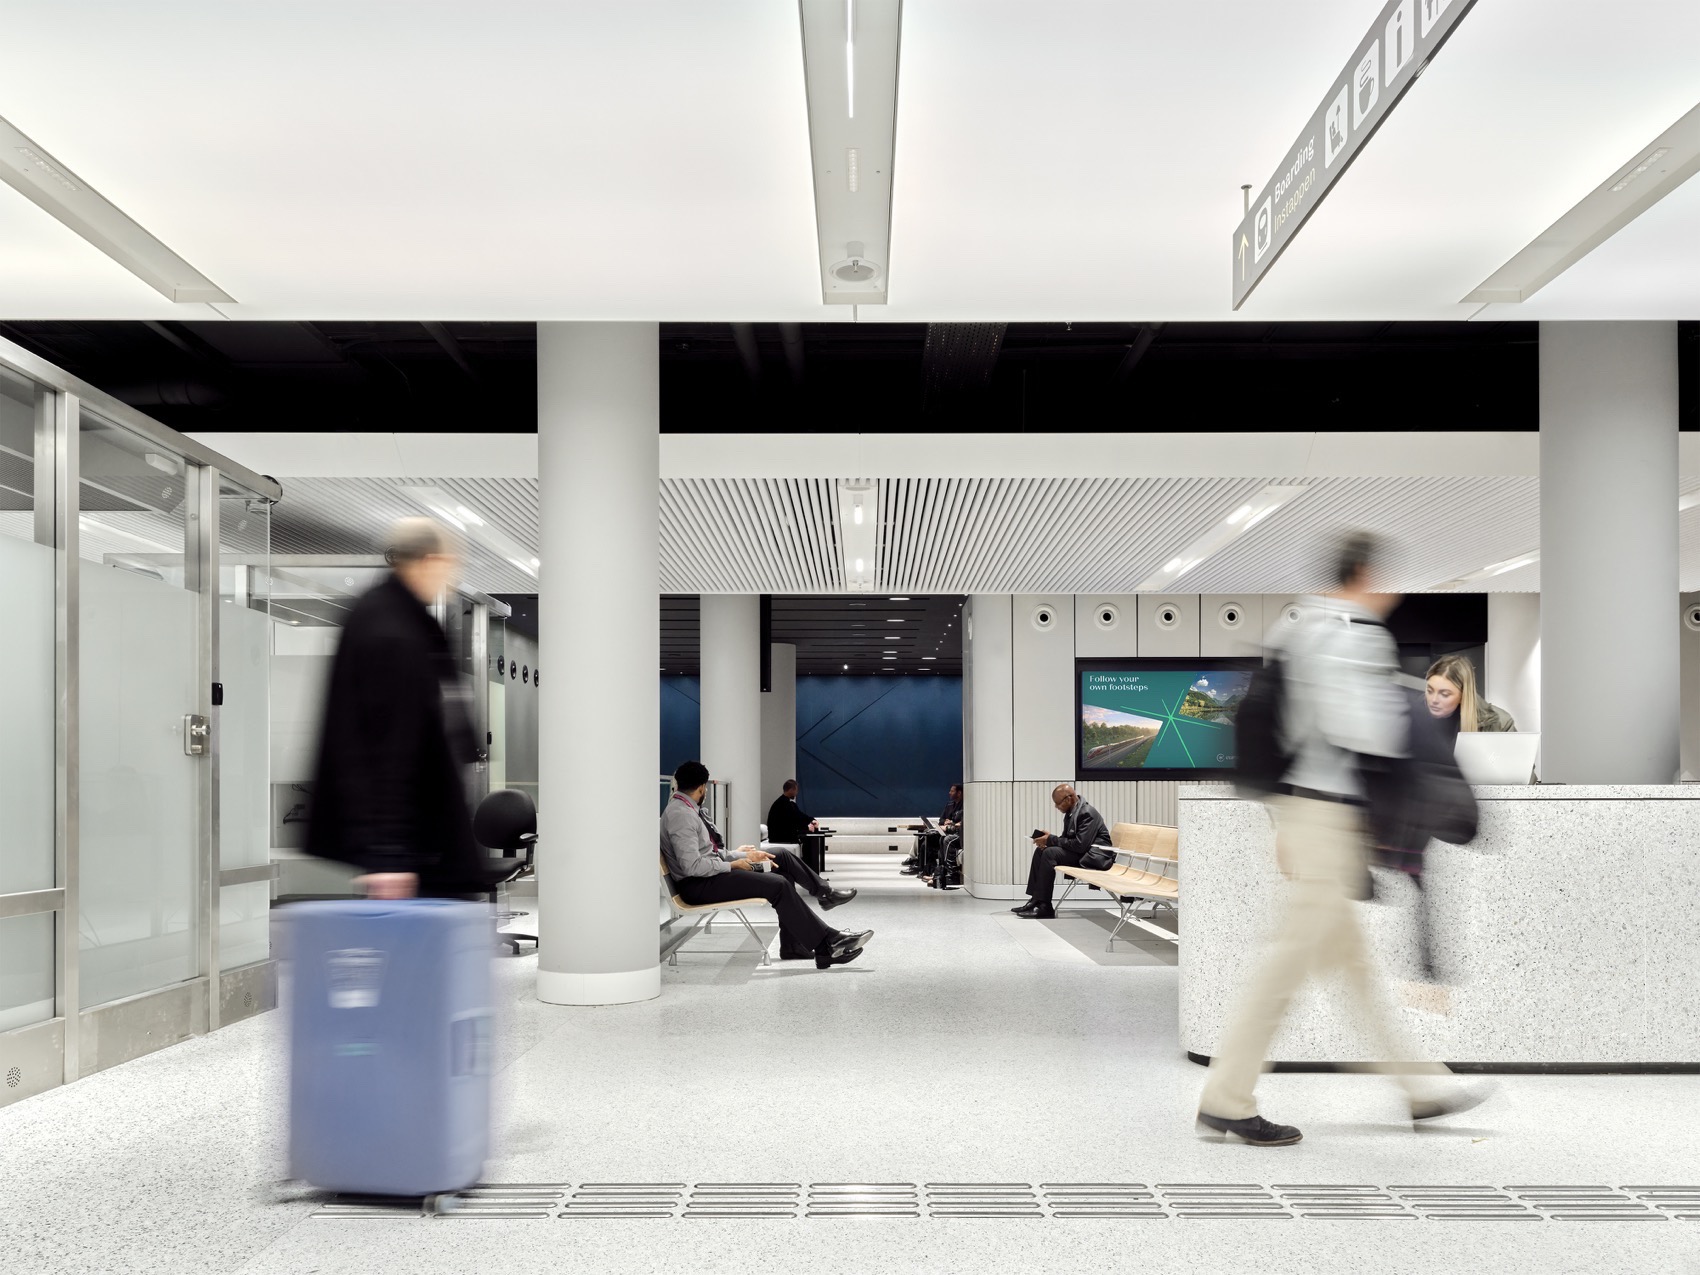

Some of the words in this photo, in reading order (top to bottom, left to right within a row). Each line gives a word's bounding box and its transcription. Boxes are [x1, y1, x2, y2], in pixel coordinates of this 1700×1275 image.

[1275, 135, 1315, 204] Boarding
[1275, 168, 1315, 234] Instappen
[1109, 683, 1149, 692] footsteps
[1119, 676, 1140, 684] your
